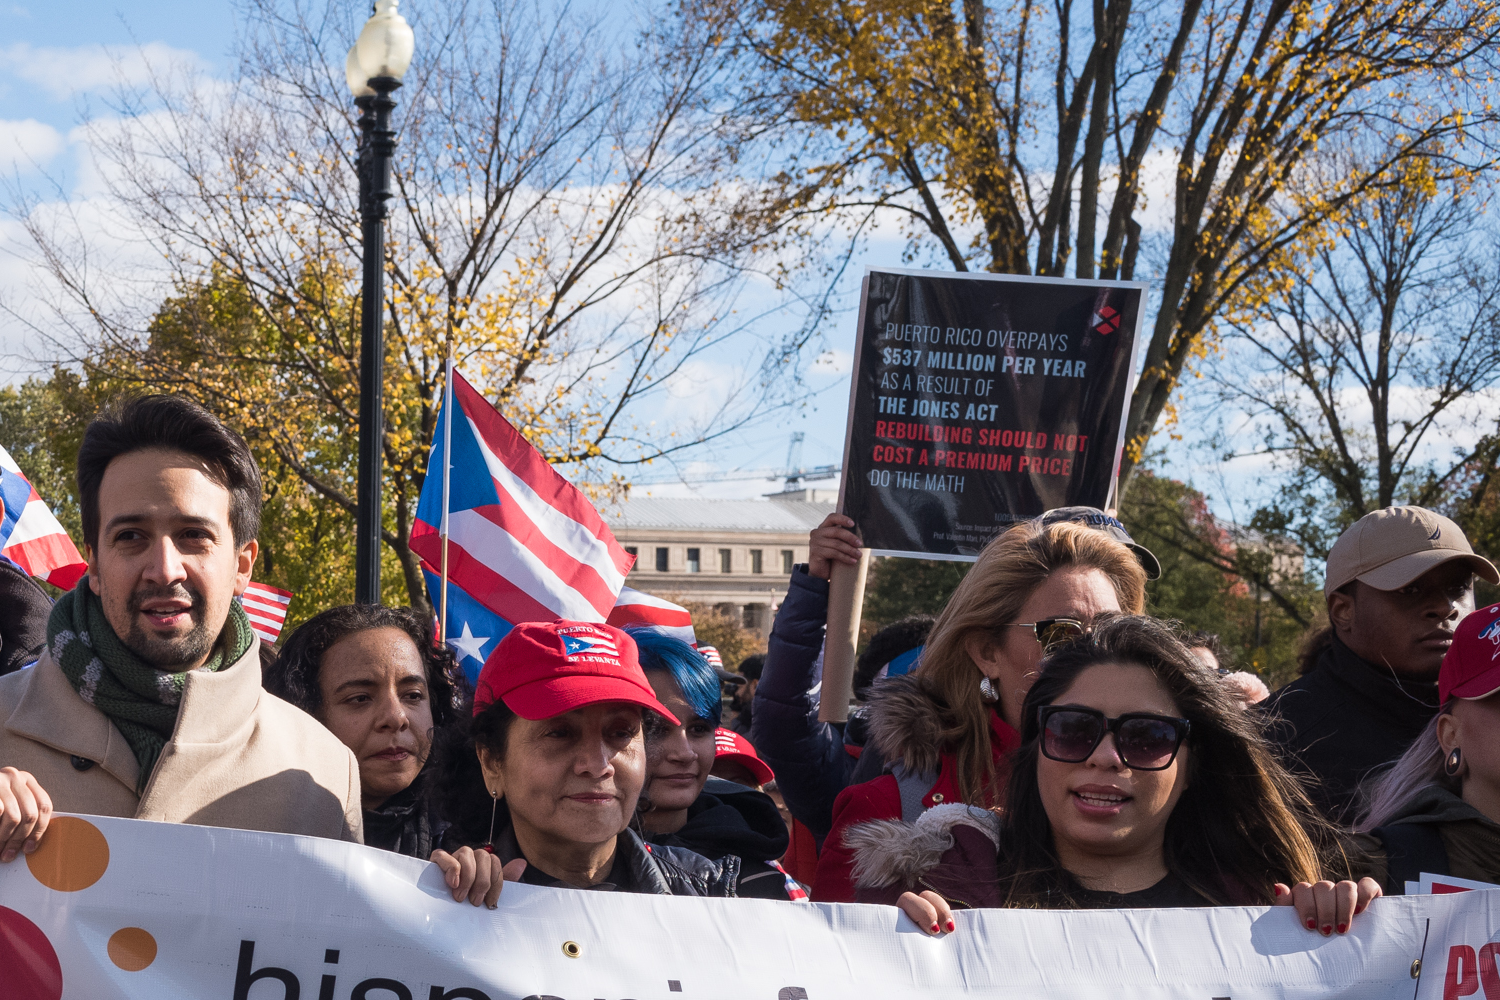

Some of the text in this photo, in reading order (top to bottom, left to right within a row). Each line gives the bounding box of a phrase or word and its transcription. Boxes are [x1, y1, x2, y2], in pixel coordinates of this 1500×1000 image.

[885, 322, 1068, 352] PUERTO RICO OVERPAYS
[882, 346, 1086, 378] $537 MILLION PER YEAR
[881, 371, 995, 397] AS A RESULT OF
[878, 396, 999, 422] THE JONES ACT
[875, 420, 1088, 452] REBUILDING SHOULD NOT
[873, 445, 1072, 476] COST A PREMIUM PRICE
[870, 469, 965, 493] DO THE MATH
[557, 626, 593, 635] PUERTO
[581, 656, 621, 666] LEVANTA
